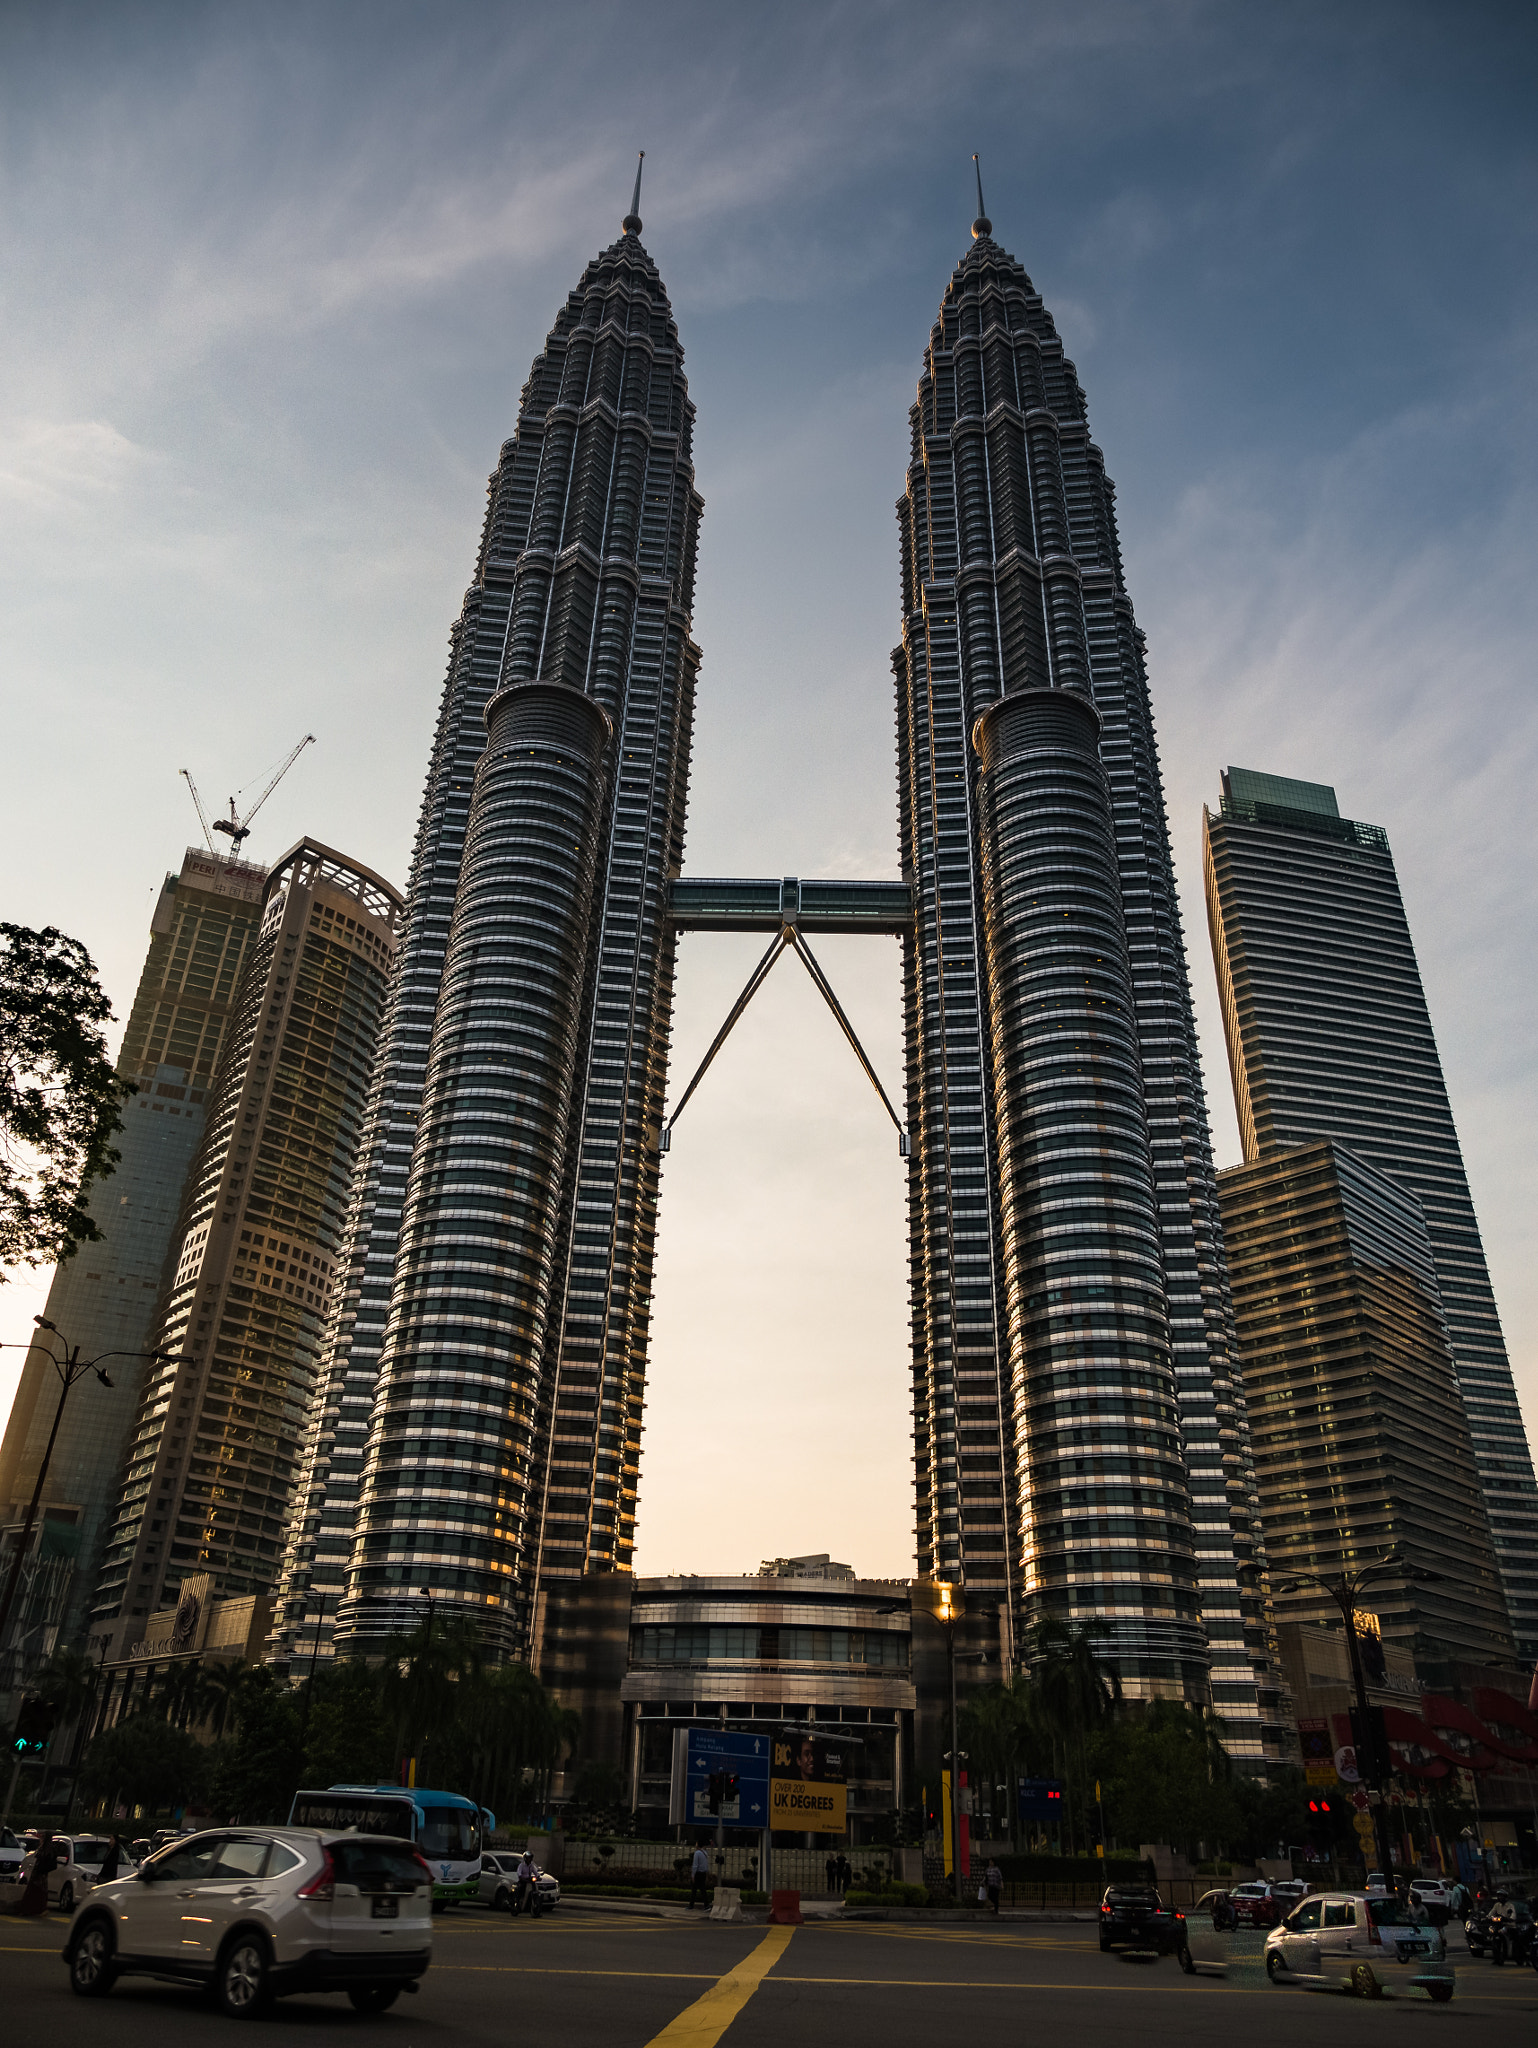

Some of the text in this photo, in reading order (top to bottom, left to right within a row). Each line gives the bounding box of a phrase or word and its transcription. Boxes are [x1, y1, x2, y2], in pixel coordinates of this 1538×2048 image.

[192, 862, 216, 875] PERI
[774, 1742, 792, 1766] BAC
[774, 1782, 805, 1794] OVER 200
[774, 1794, 834, 1811] UK DEGREES
